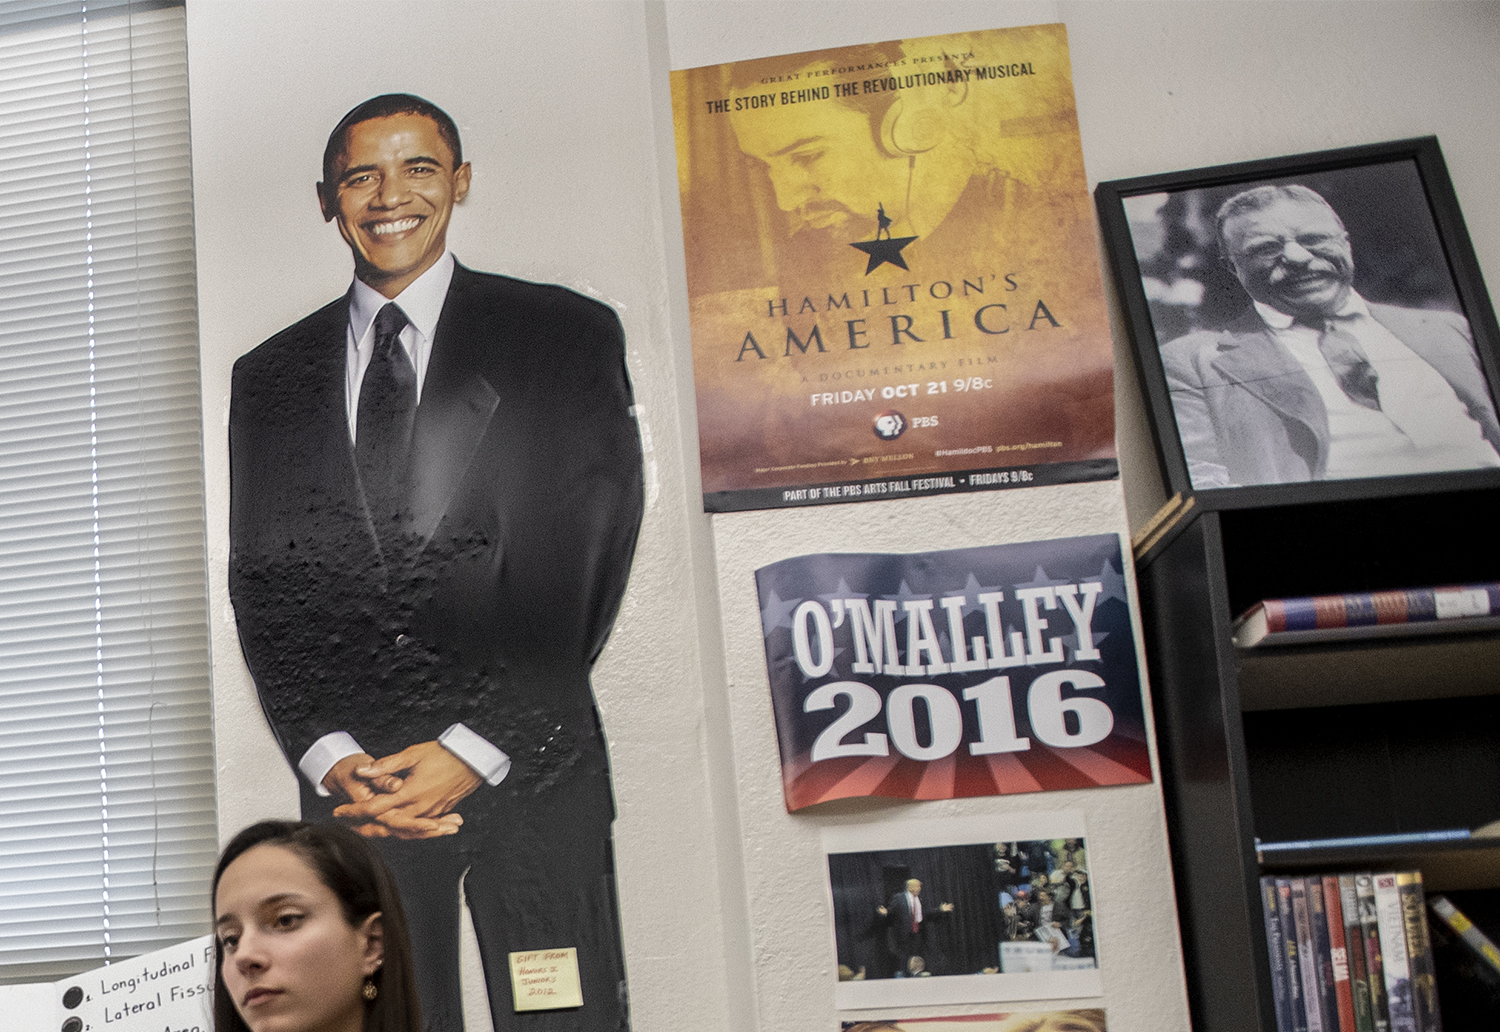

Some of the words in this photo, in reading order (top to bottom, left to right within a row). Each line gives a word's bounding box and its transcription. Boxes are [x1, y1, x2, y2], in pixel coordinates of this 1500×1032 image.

[761, 73, 801, 85] GREAT
[807, 59, 907, 79] PERFORMANCES
[913, 51, 976, 65] PRESENTS
[706, 98, 731, 114] THE
[735, 92, 777, 111] STORY
[781, 86, 830, 106] BEHIND
[834, 81, 859, 98] THE
[863, 69, 972, 95] REVOLUTIONARY
[976, 62, 1036, 81] MUSICAL
[767, 272, 1019, 318] HAMILTON'S
[735, 298, 1064, 362] AMERICA
[819, 360, 948, 383] DOCUMENTARY
[958, 355, 999, 367] FILM
[810, 387, 876, 407] FRIDAY
[881, 383, 920, 400] OCT
[926, 380, 948, 395] 21
[953, 376, 993, 392] 9/8c
[912, 416, 939, 428] PBS
[882, 453, 915, 462] MELLON
[783, 489, 807, 502] PART
[810, 488, 822, 499] OF
[823, 486, 841, 498] THE
[843, 484, 862, 496] PBS
[864, 482, 887, 494] ARTS
[889, 480, 911, 492] FALL
[912, 476, 956, 491] FESTIVAL
[969, 471, 1009, 486] FRIDAYS
[792, 582, 1102, 678] O'MALLEY
[803, 668, 1114, 763] 2016
[544, 951, 568, 960] FROM
[1331, 948, 1350, 982] SELMA
[100, 953, 195, 996] Longitudinal
[528, 988, 556, 996] 2012
[104, 993, 162, 1024] Lateral
